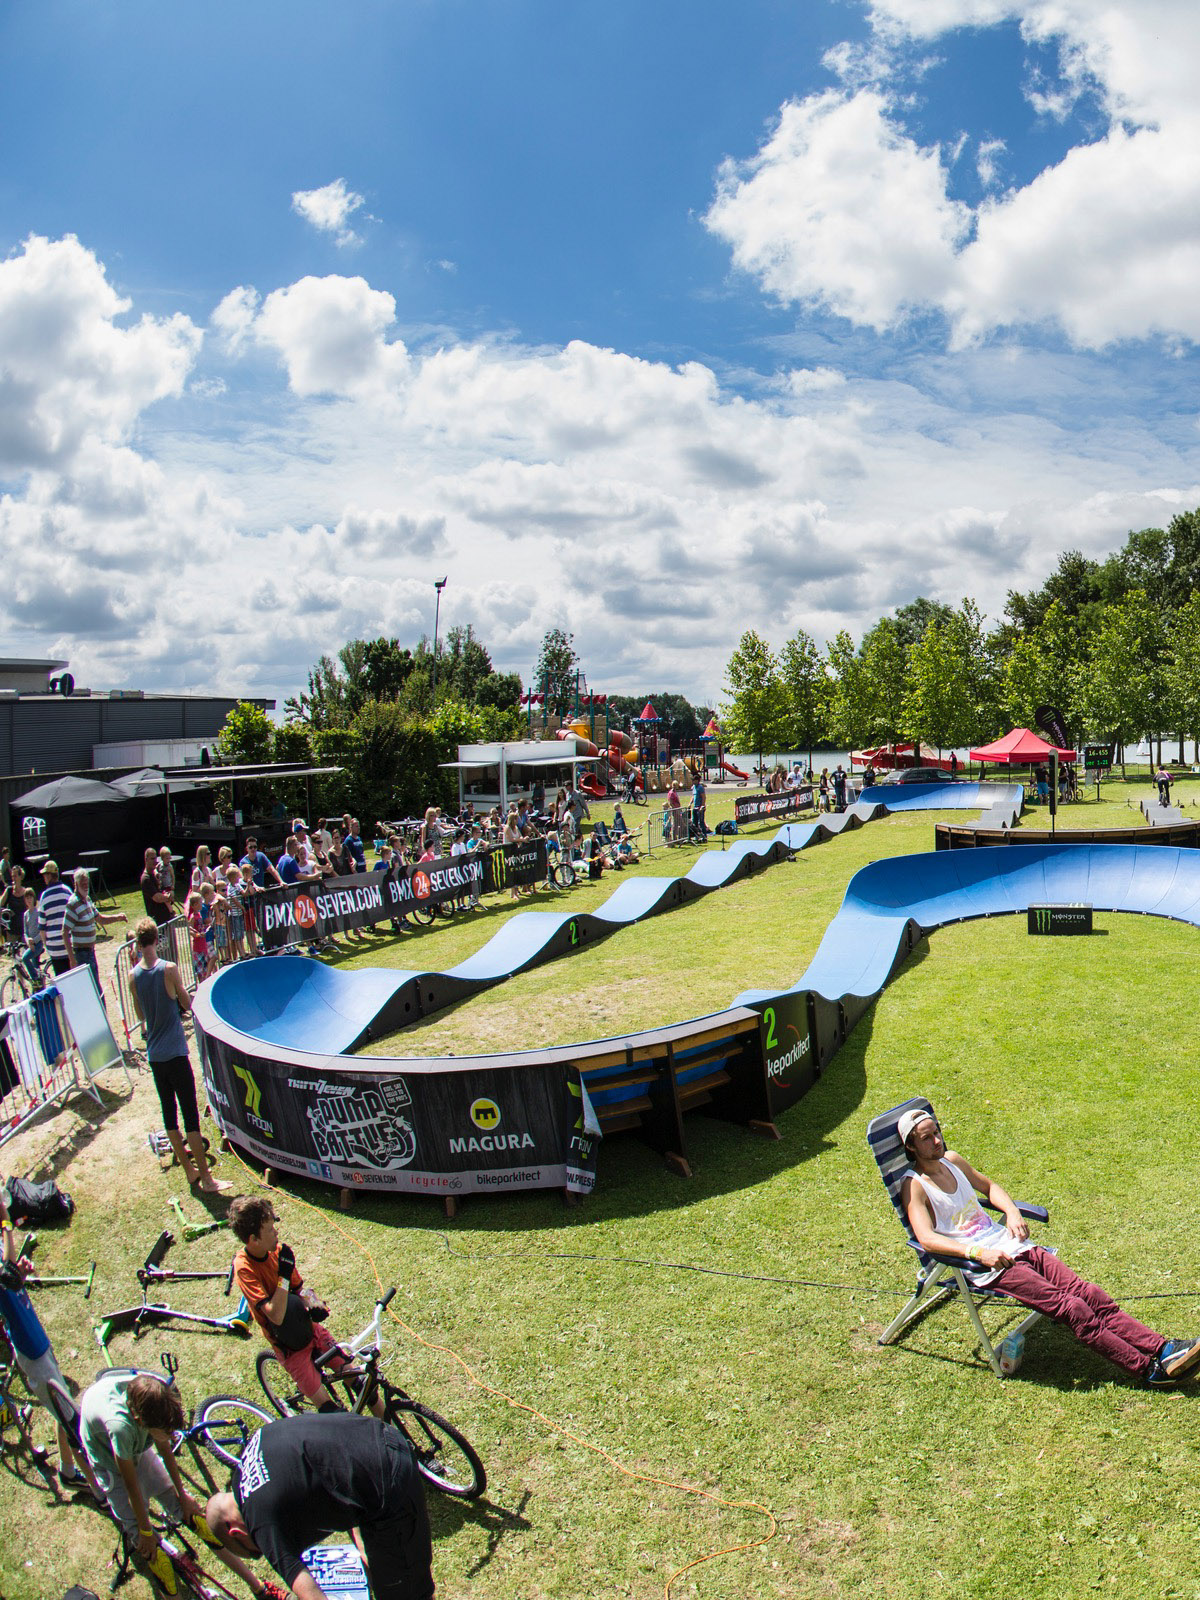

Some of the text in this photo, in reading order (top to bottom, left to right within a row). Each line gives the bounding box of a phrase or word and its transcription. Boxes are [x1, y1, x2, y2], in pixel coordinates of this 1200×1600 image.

[504, 851, 538, 866] MONSTER
[388, 860, 484, 903] BMX 24 SEVEN.COM
[265, 884, 382, 931] BMX 24 SEVEN.COM
[570, 921, 579, 945] 2
[763, 1007, 778, 1050] 2
[317, 1091, 387, 1127] PUMP
[449, 1132, 536, 1154] MAGURA
[363, 1173, 398, 1185] SEVEN.COM
[410, 1174, 449, 1187] icycle
[476, 1170, 542, 1187] bikeparkitect
